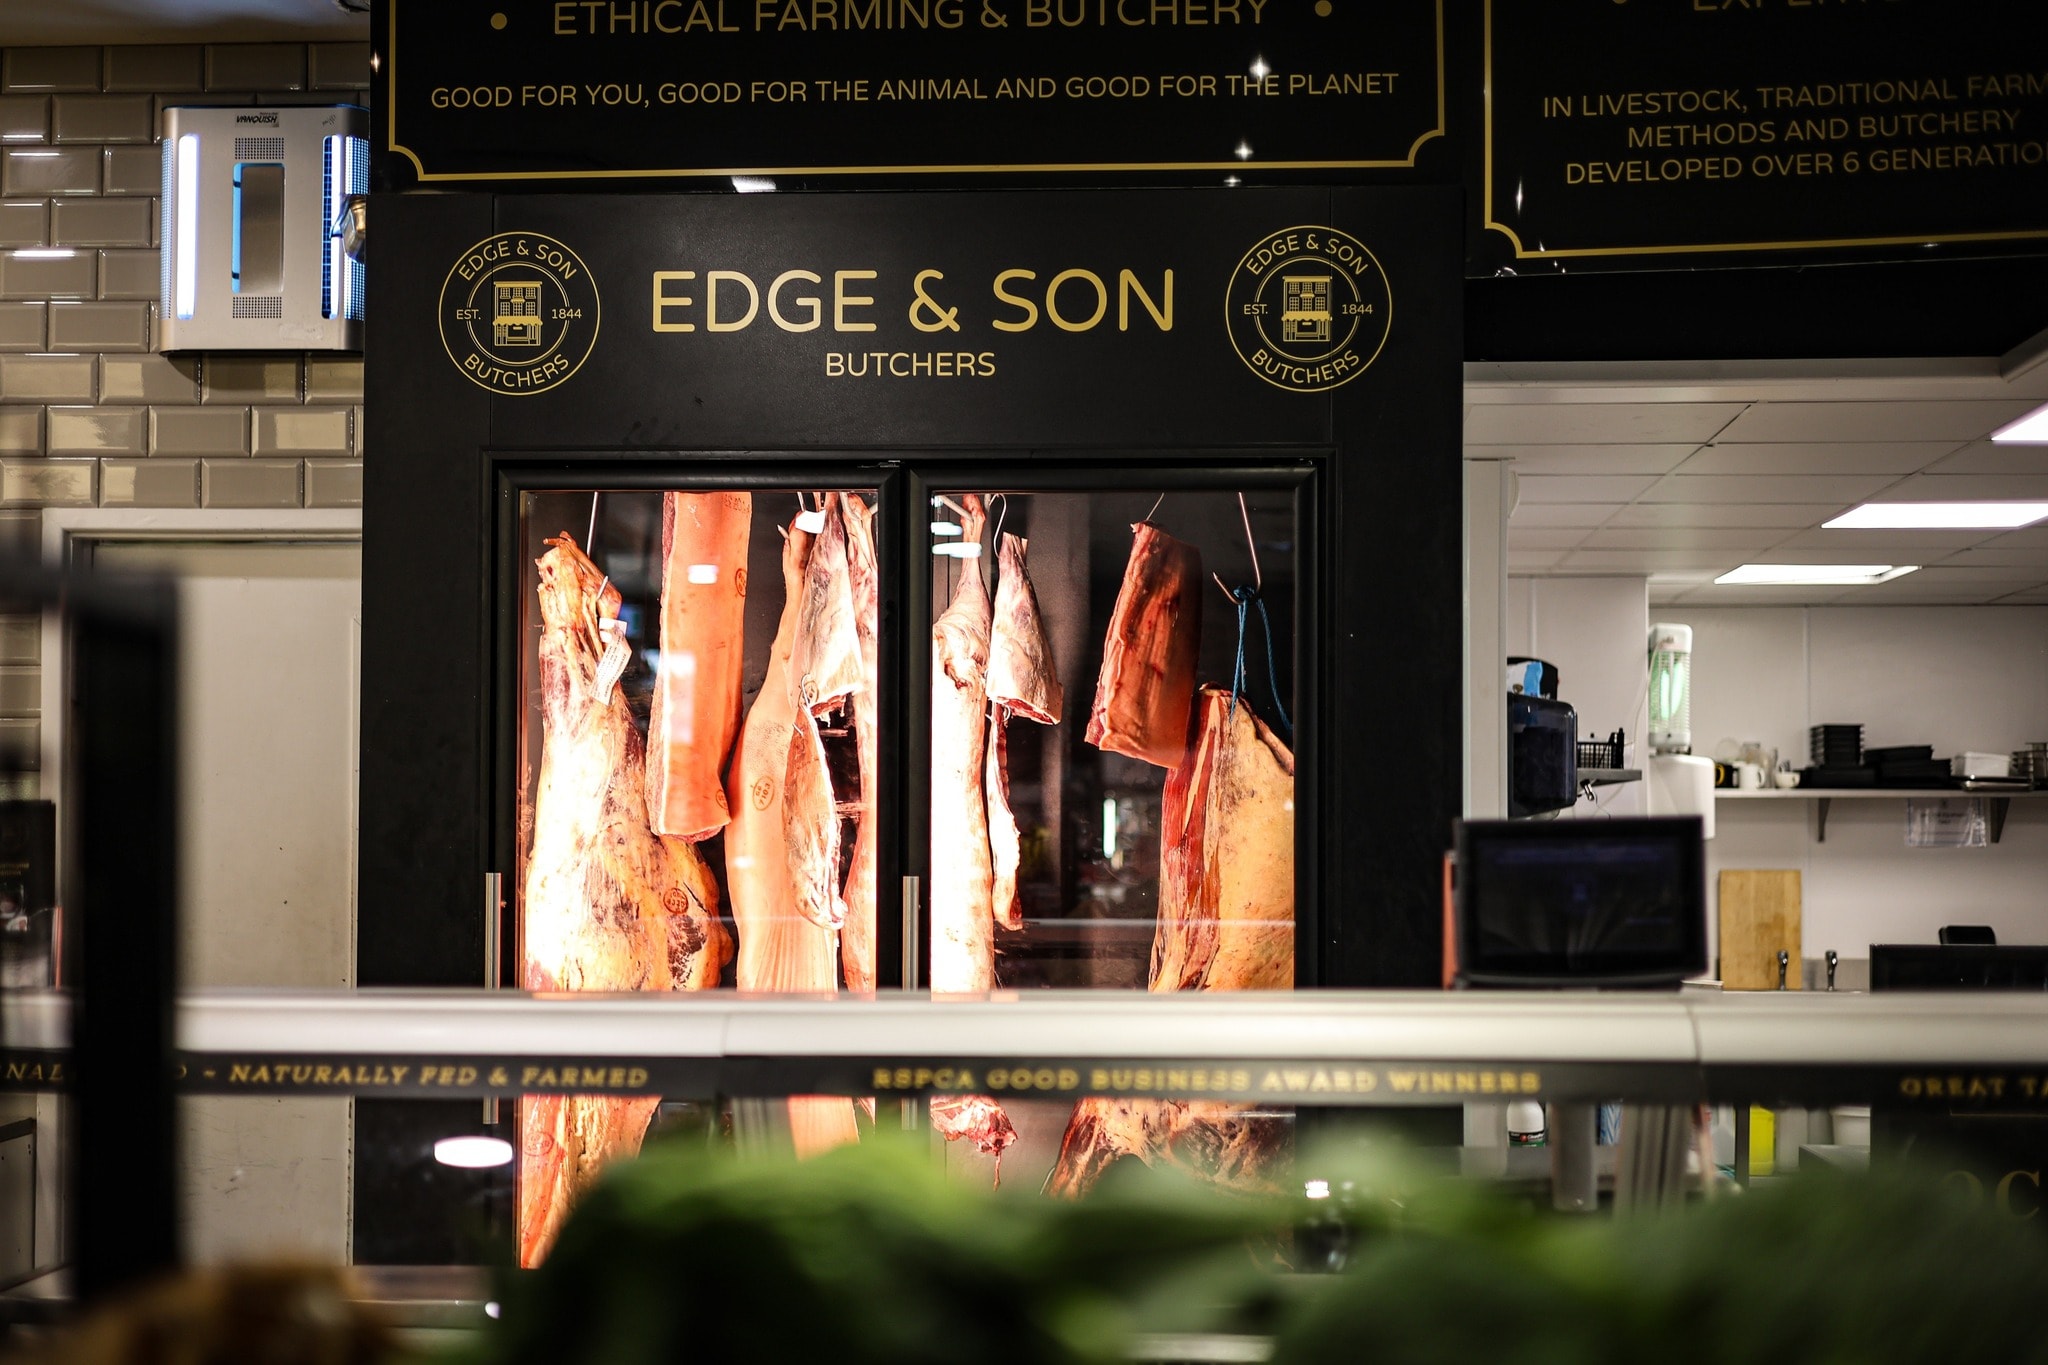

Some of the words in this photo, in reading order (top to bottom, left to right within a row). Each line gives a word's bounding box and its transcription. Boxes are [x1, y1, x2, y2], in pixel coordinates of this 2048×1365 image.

[554, 1, 740, 35] ETHICAL
[755, 0, 964, 32] FARMING
[980, 0, 1010, 29] &
[1026, 0, 1268, 28] BUTCHERY
[431, 86, 513, 109] GOOD
[522, 84, 577, 107] FOR
[585, 83, 650, 109] YOU,
[658, 82, 742, 105] GOOD
[751, 81, 807, 103] FOR
[814, 79, 869, 102] THE
[876, 78, 988, 101] ANIMAL
[995, 77, 1057, 99] AND
[1065, 76, 1151, 99] GOOD
[1159, 75, 1217, 97] FOR
[1224, 74, 1280, 96] THE
[1289, 72, 1399, 95] PLANET
[1544, 96, 1572, 118] IN
[1582, 88, 1748, 116] LIVESTOCK,
[1756, 78, 1959, 109] TRADITIONAL
[1628, 121, 1776, 149] METHODS
[1784, 118, 1849, 142] AND
[1859, 108, 2021, 138] BUTCHERY
[1566, 156, 1743, 185] DEVELOPED
[1751, 152, 1833, 177] OVER
[1842, 151, 1860, 174] 6
[1869, 141, 2048, 172] GENERATIO
[458, 240, 511, 281] EDGE
[516, 239, 529, 256] &
[535, 244, 577, 280] SON
[1246, 234, 1300, 275] EDGE
[1306, 233, 1319, 250] &
[1325, 238, 1369, 275] SON
[456, 309, 482, 320] EST.
[551, 308, 583, 320] 1844
[652, 269, 878, 333] EDGE
[908, 269, 961, 333] &
[992, 268, 1174, 332] SON
[1243, 304, 1269, 315] EST.
[1341, 303, 1373, 315] 1844
[463, 353, 570, 388] BUTCHERS
[826, 352, 996, 377] BUTCHERS
[1251, 348, 1360, 384] BUTCHERS
[229, 1064, 409, 1085] NATURALLY
[418, 1065, 479, 1087] FED
[487, 1066, 509, 1087] &
[520, 1066, 649, 1088] FARMED
[1091, 1068, 1250, 1092] BUSINESS
[1260, 1069, 1377, 1093] AWARD
[1387, 1070, 1542, 1094] WINNERS
